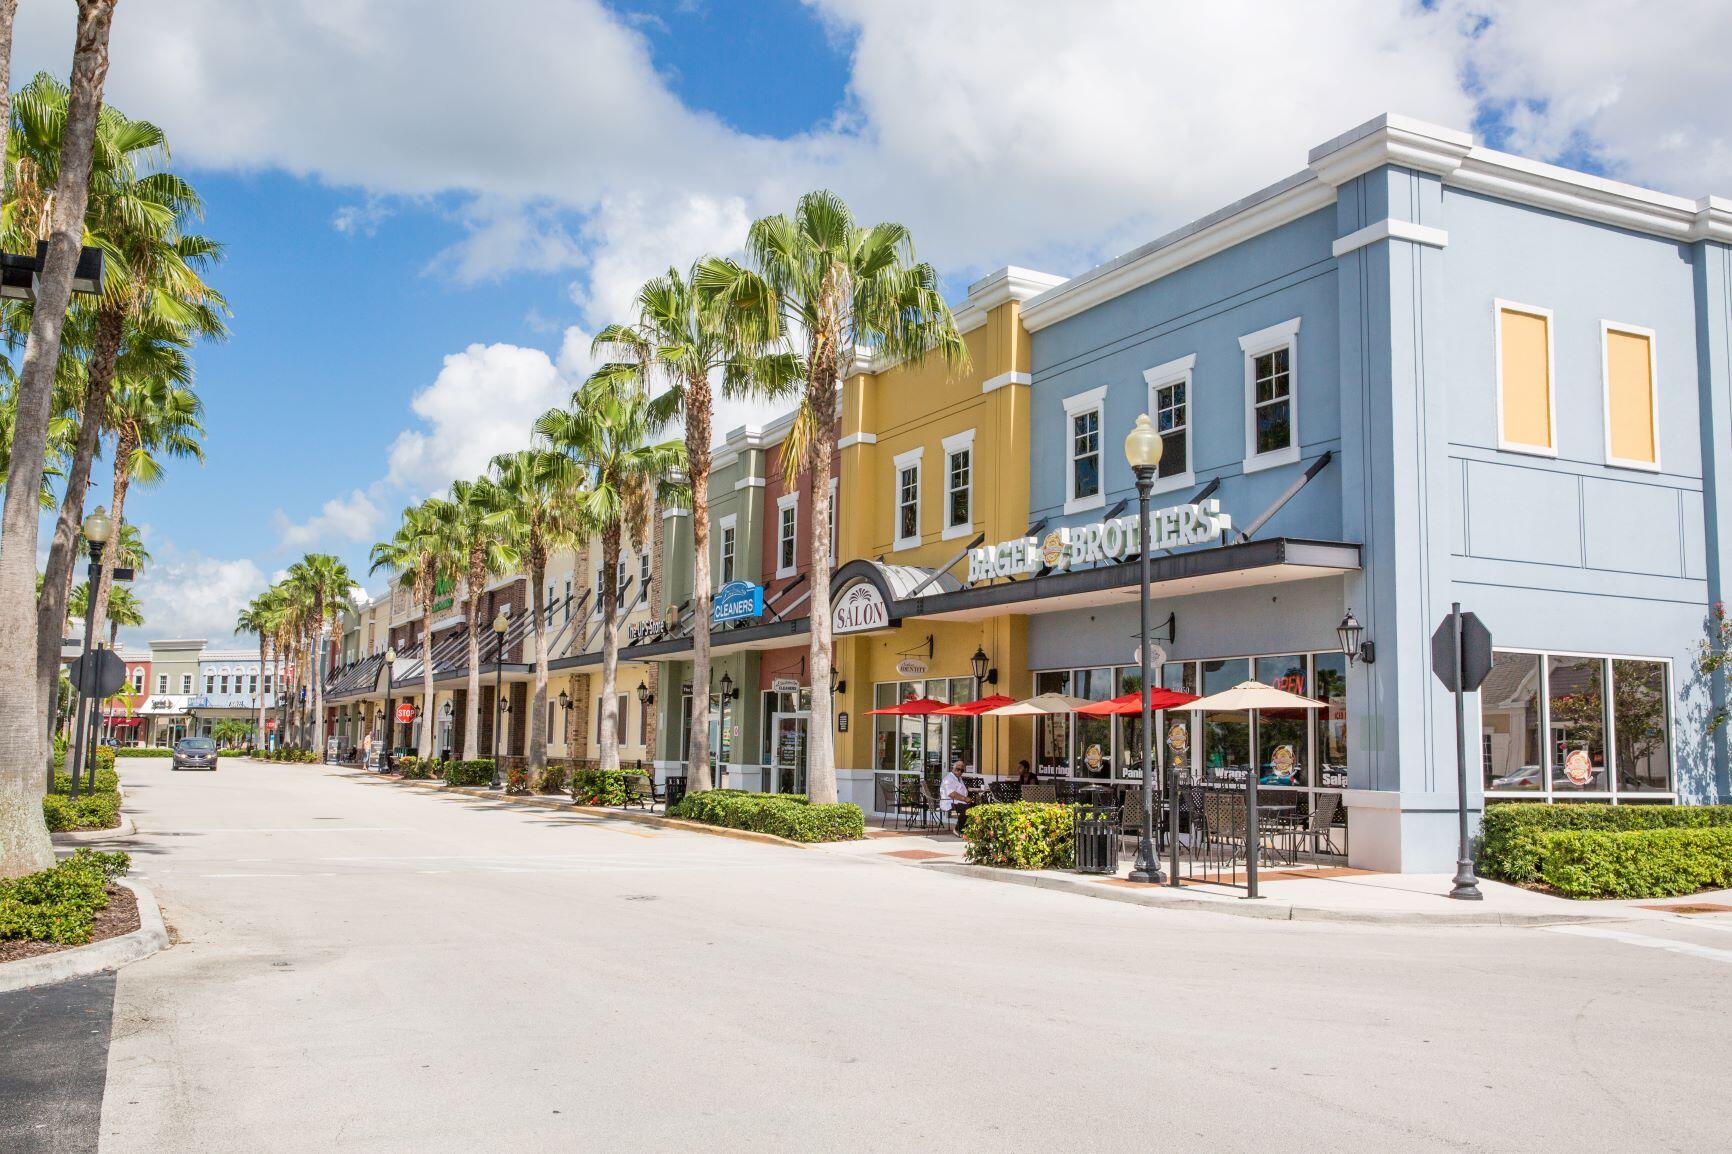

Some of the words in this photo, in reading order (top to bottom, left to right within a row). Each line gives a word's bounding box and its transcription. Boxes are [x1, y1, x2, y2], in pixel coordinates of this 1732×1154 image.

[968, 537, 1042, 582] BAGEL
[1071, 499, 1231, 564] BROTHERS
[715, 599, 753, 618] CLEANERS
[837, 601, 884, 629] SALON
[1273, 674, 1304, 695] OPEN
[398, 709, 415, 717] STOP
[1322, 773, 1348, 786] Sala
